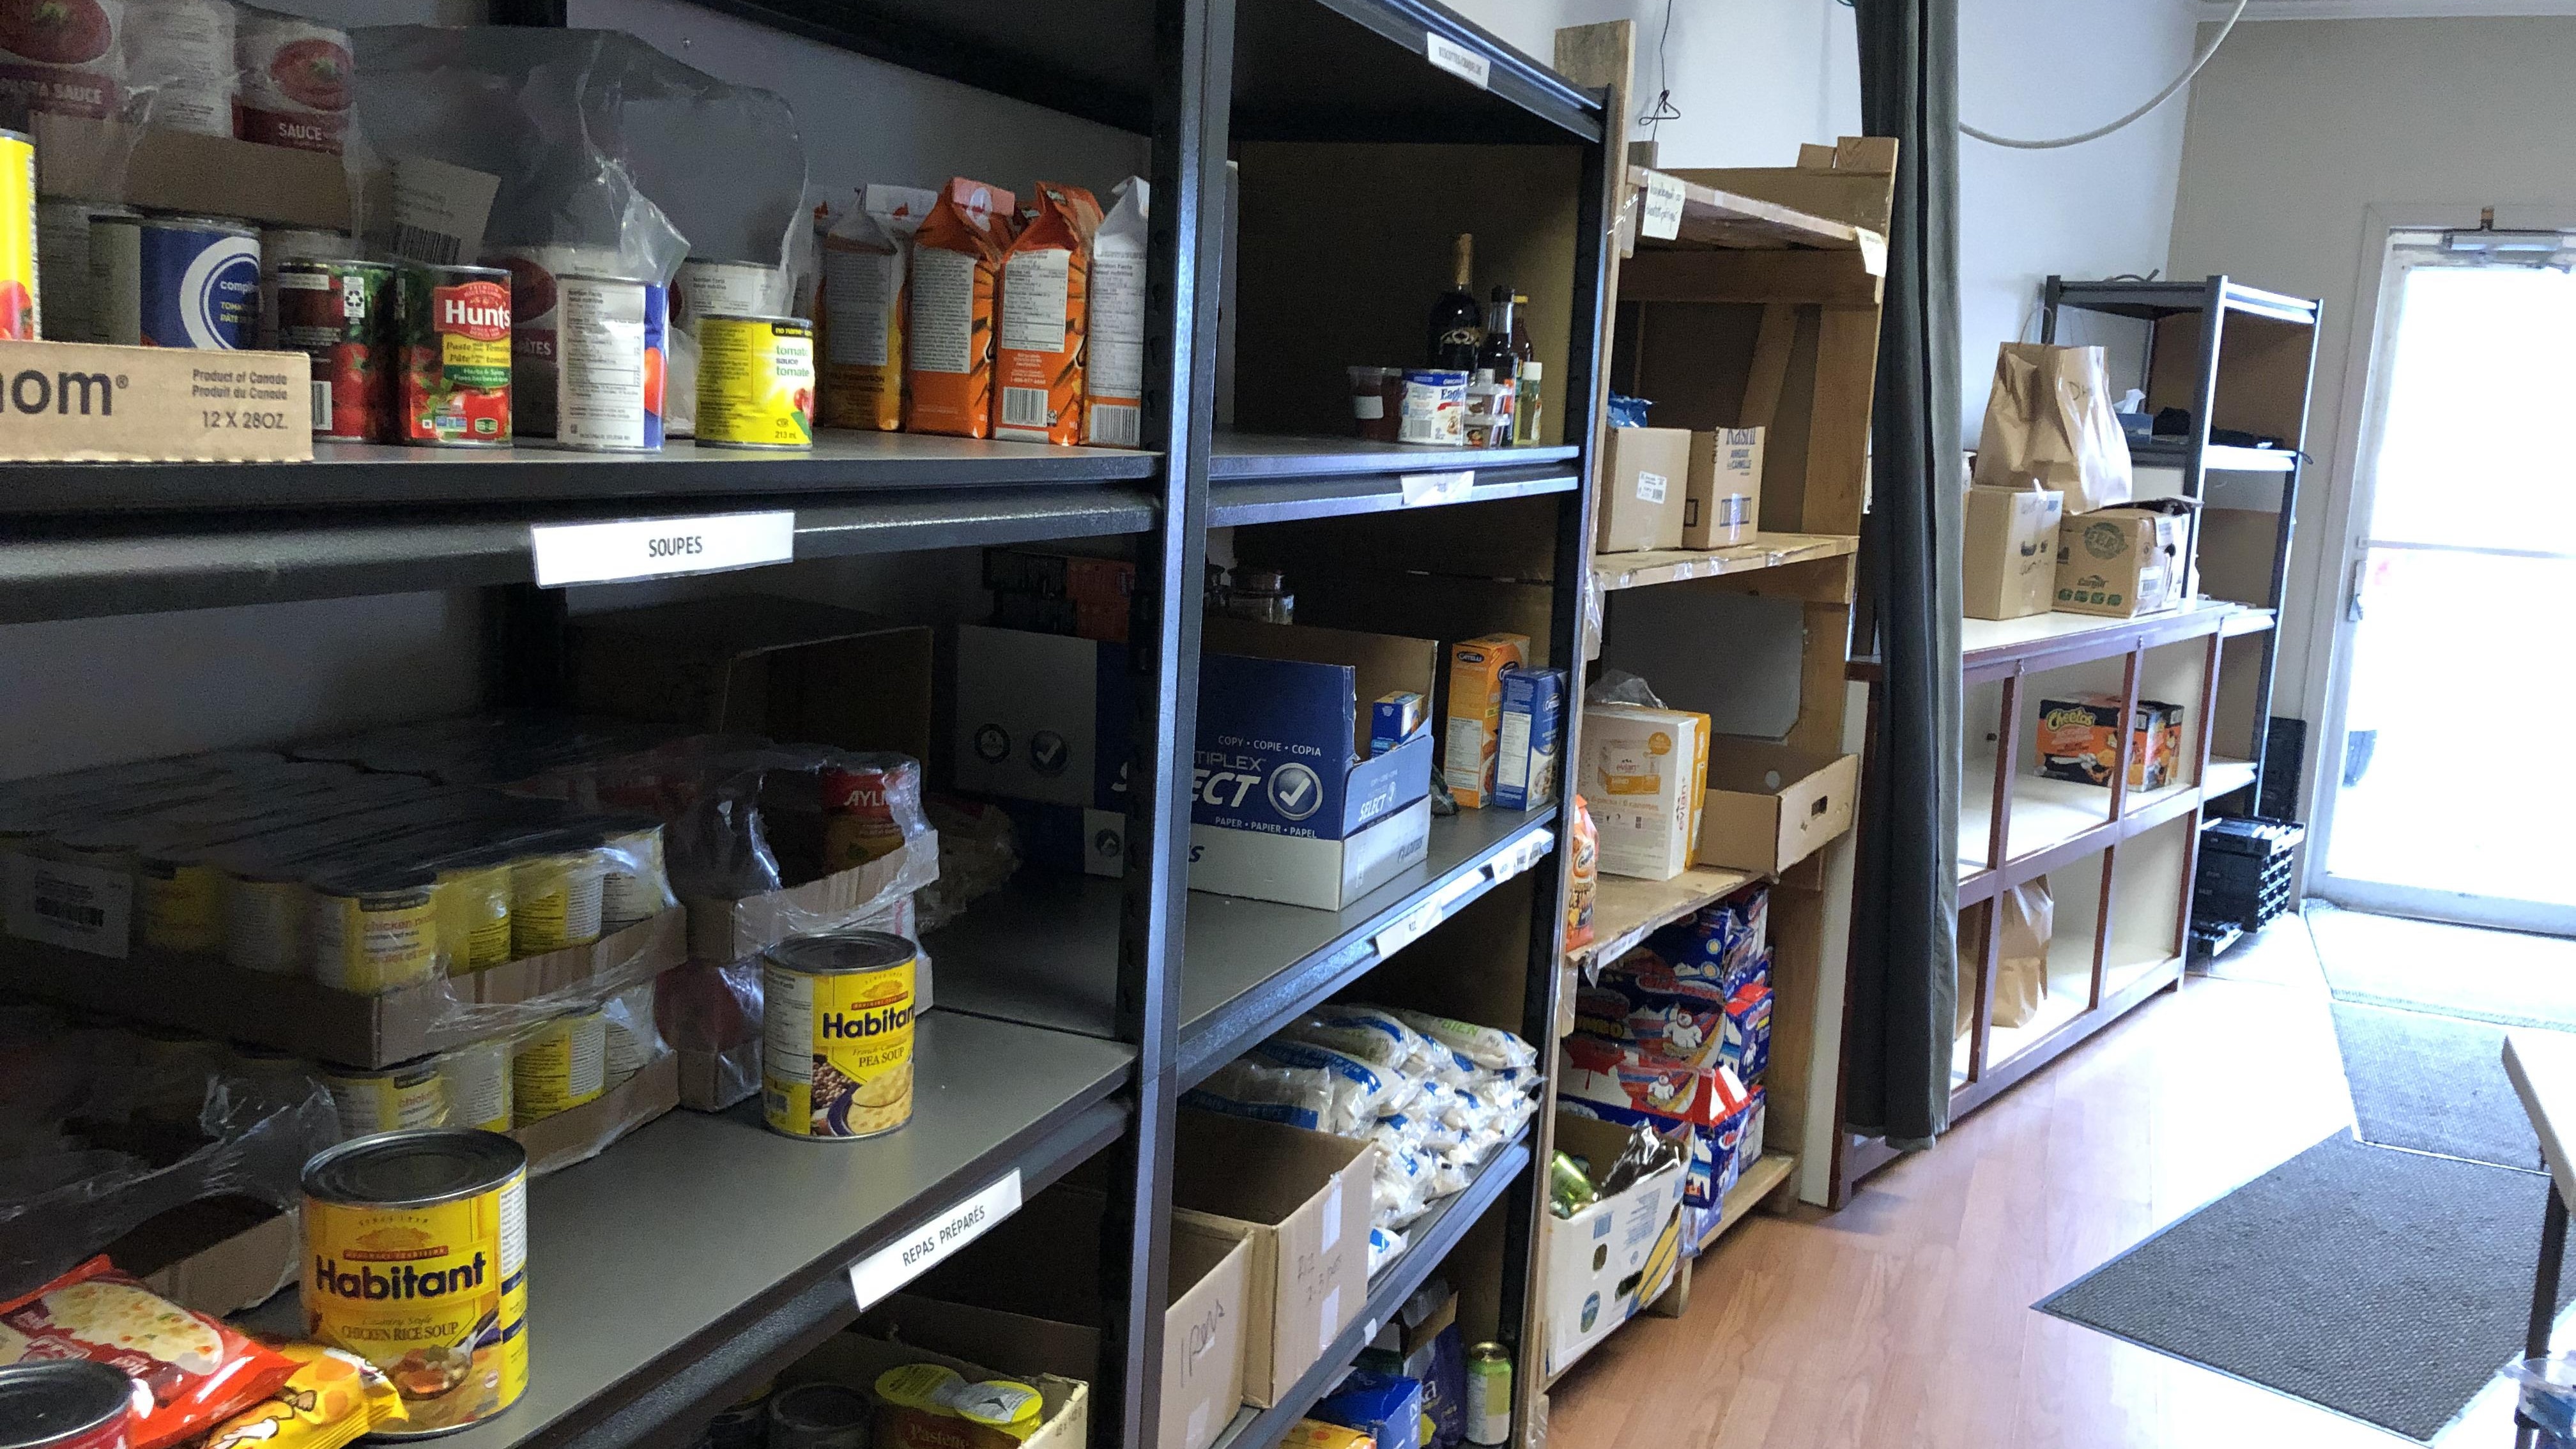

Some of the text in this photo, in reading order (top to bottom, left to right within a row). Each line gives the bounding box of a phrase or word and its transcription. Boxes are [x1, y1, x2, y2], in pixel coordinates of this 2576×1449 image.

[279, 123, 322, 141] SAUCE
[192, 369, 288, 385] Product of Canada
[776, 365, 809, 377] tomate
[192, 385, 288, 401] Produit du Canada
[202, 411, 220, 427] 12
[226, 411, 237, 427] X
[774, 431, 788, 440] 213
[648, 536, 703, 558] SOUPES
[2047, 708, 2094, 732] Cheetos
[1217, 735, 1322, 757] COPY COPIE COPIA
[1358, 792, 1387, 822] SELECT
[1678, 785, 1687, 831] evian
[1215, 816, 1317, 839] PAPER PAPIER PAPEL
[858, 1046, 905, 1068] PEA SOUP
[902, 1205, 985, 1267] REPAS PRÉPARÉS
[316, 1251, 487, 1300] Habitant
[341, 1321, 459, 1341] CHICKEN RICE SOUP
